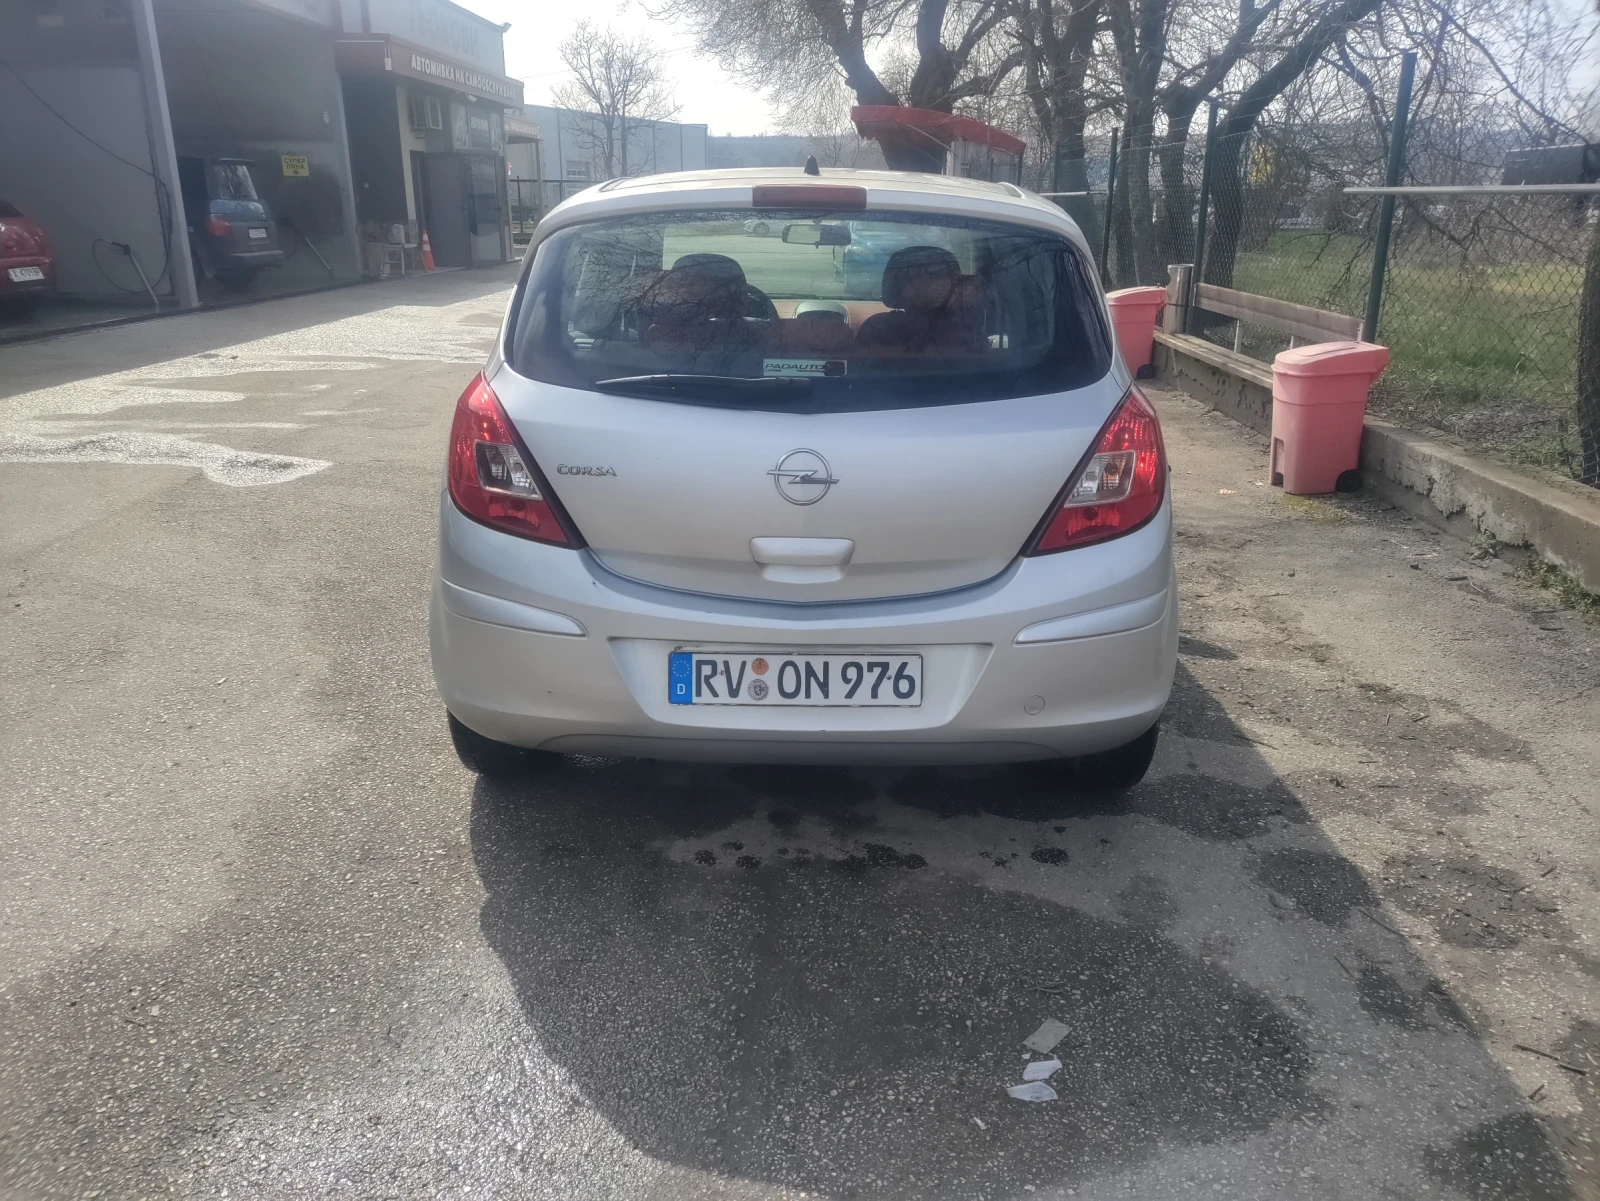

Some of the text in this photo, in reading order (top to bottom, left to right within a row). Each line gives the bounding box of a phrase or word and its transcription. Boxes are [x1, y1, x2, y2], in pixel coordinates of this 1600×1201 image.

[411, 54, 454, 81] АВТОМИВКА
[455, 69, 465, 85] НА
[557, 463, 618, 477] CORSA
[677, 683, 686, 695] D
[695, 659, 747, 699] RV
[777, 660, 830, 700] ON
[840, 661, 916, 700] 976
